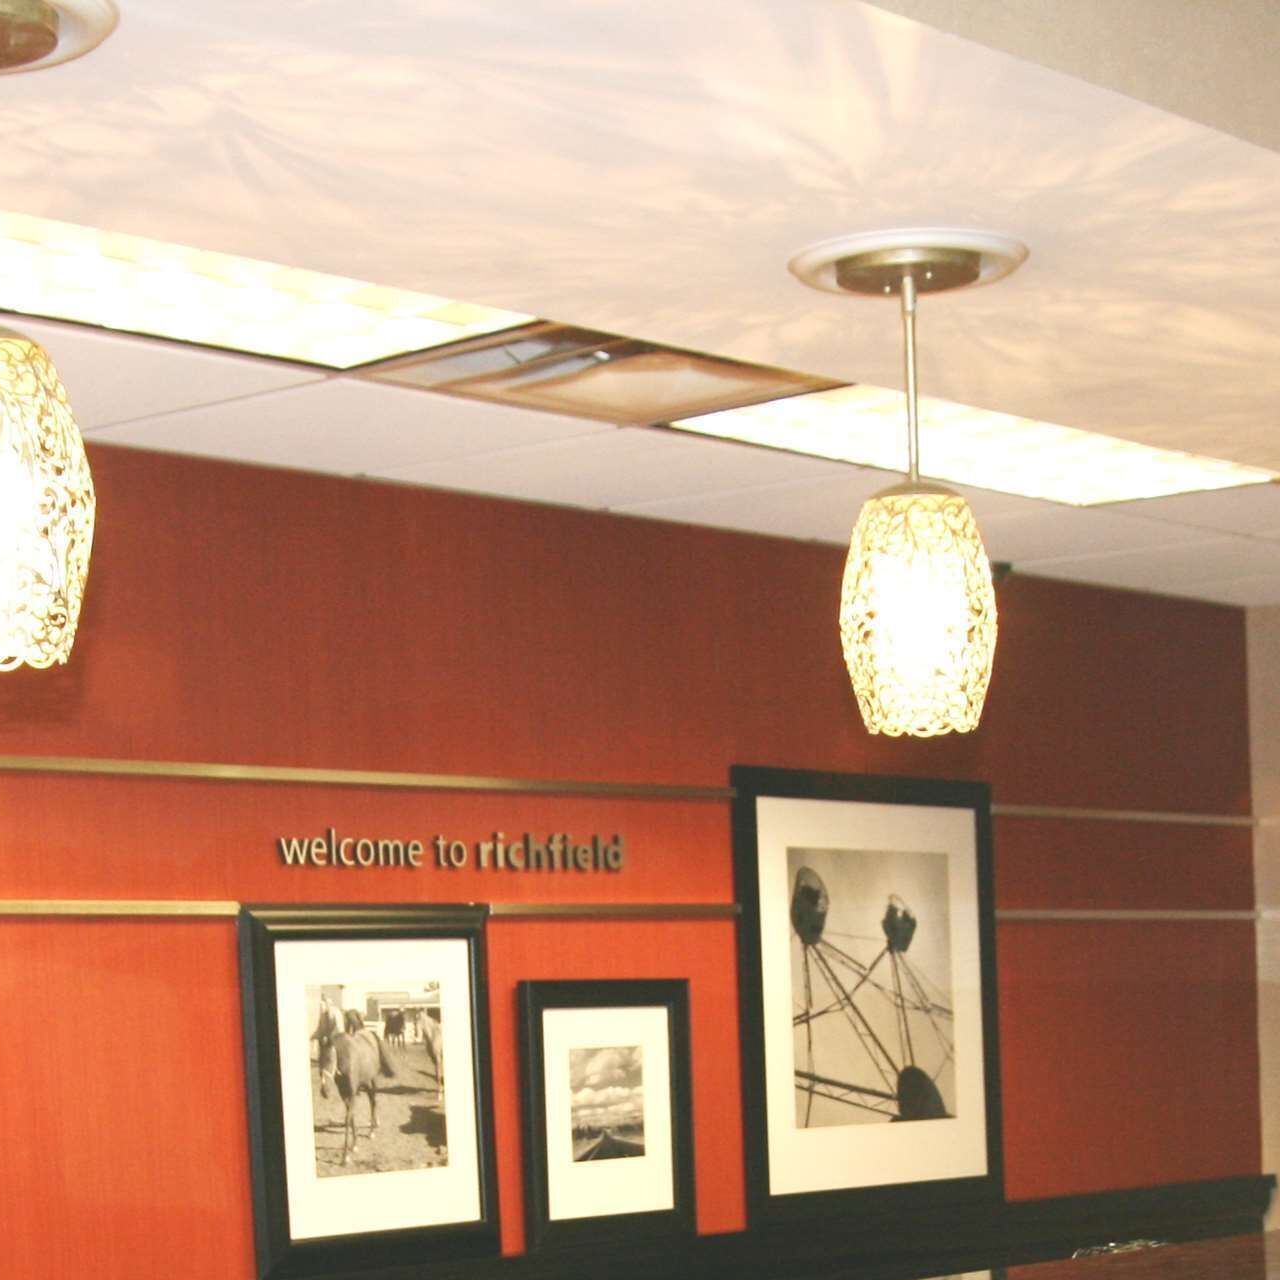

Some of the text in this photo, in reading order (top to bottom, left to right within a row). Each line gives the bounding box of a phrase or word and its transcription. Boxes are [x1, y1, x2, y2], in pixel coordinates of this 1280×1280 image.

[278, 828, 625, 873] welcome to richfield
